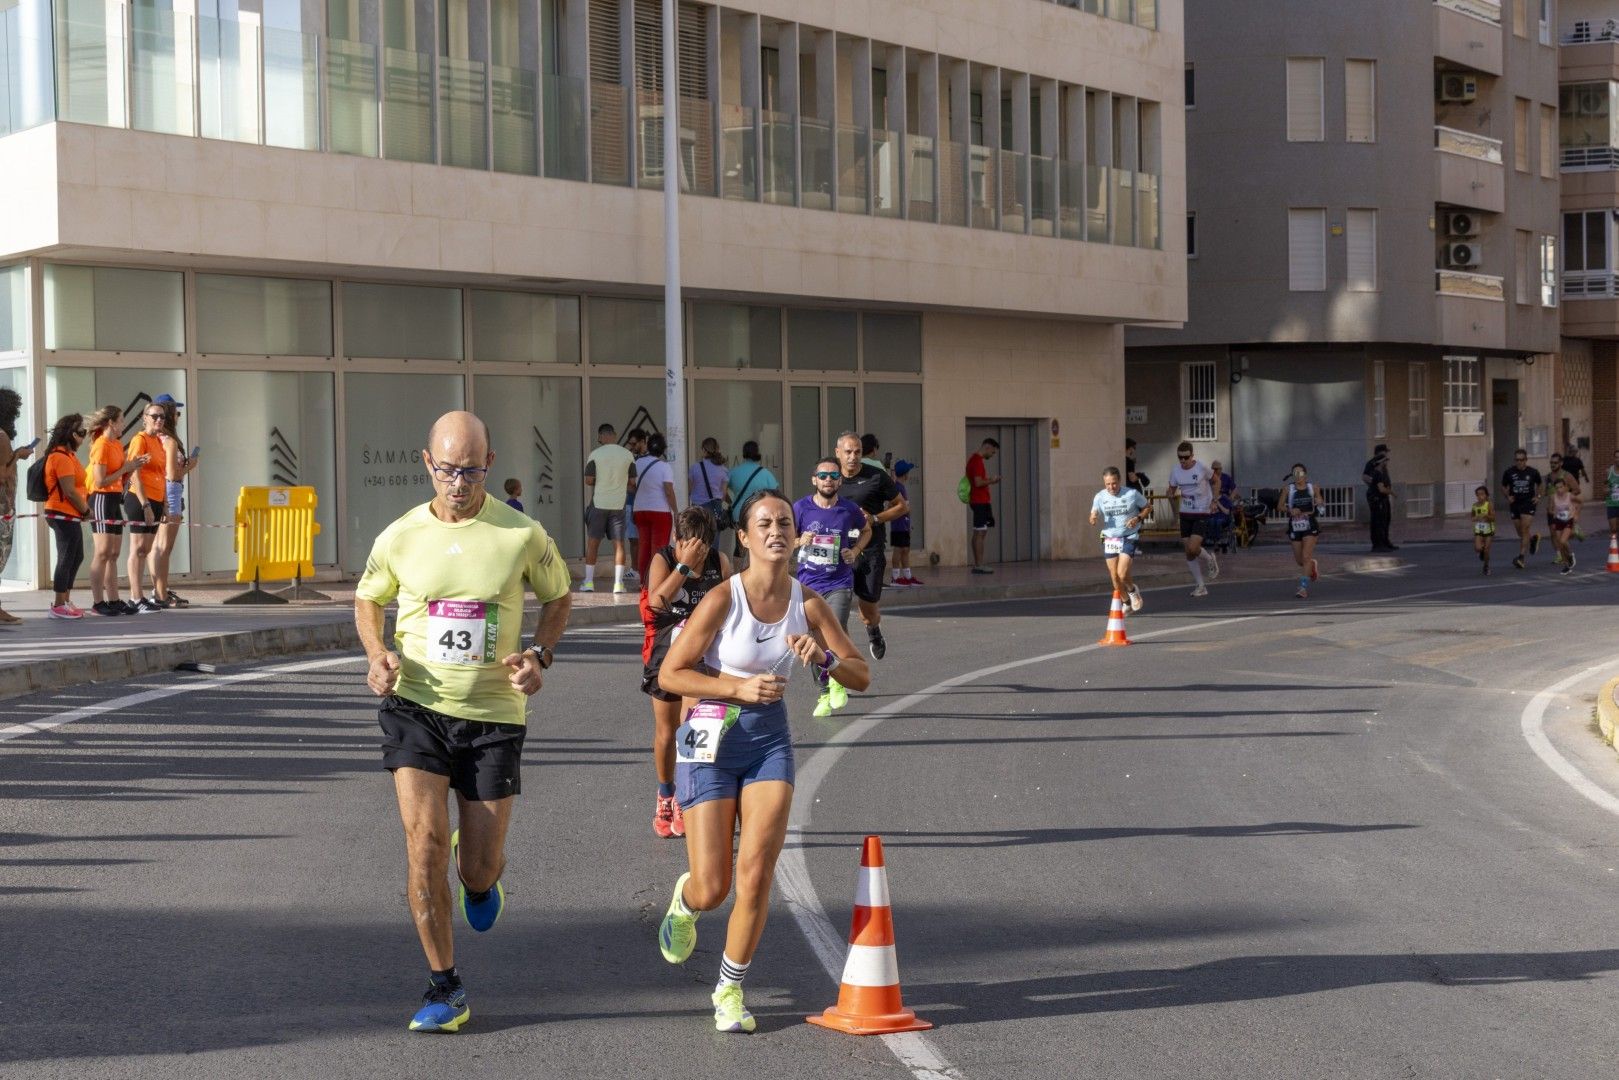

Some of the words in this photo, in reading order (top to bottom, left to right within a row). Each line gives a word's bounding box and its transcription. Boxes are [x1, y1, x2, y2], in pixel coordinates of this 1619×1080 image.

[813, 548, 828, 557] 53
[438, 630, 472, 650] 43
[487, 623, 497, 641] KM
[684, 729, 709, 749] 42
